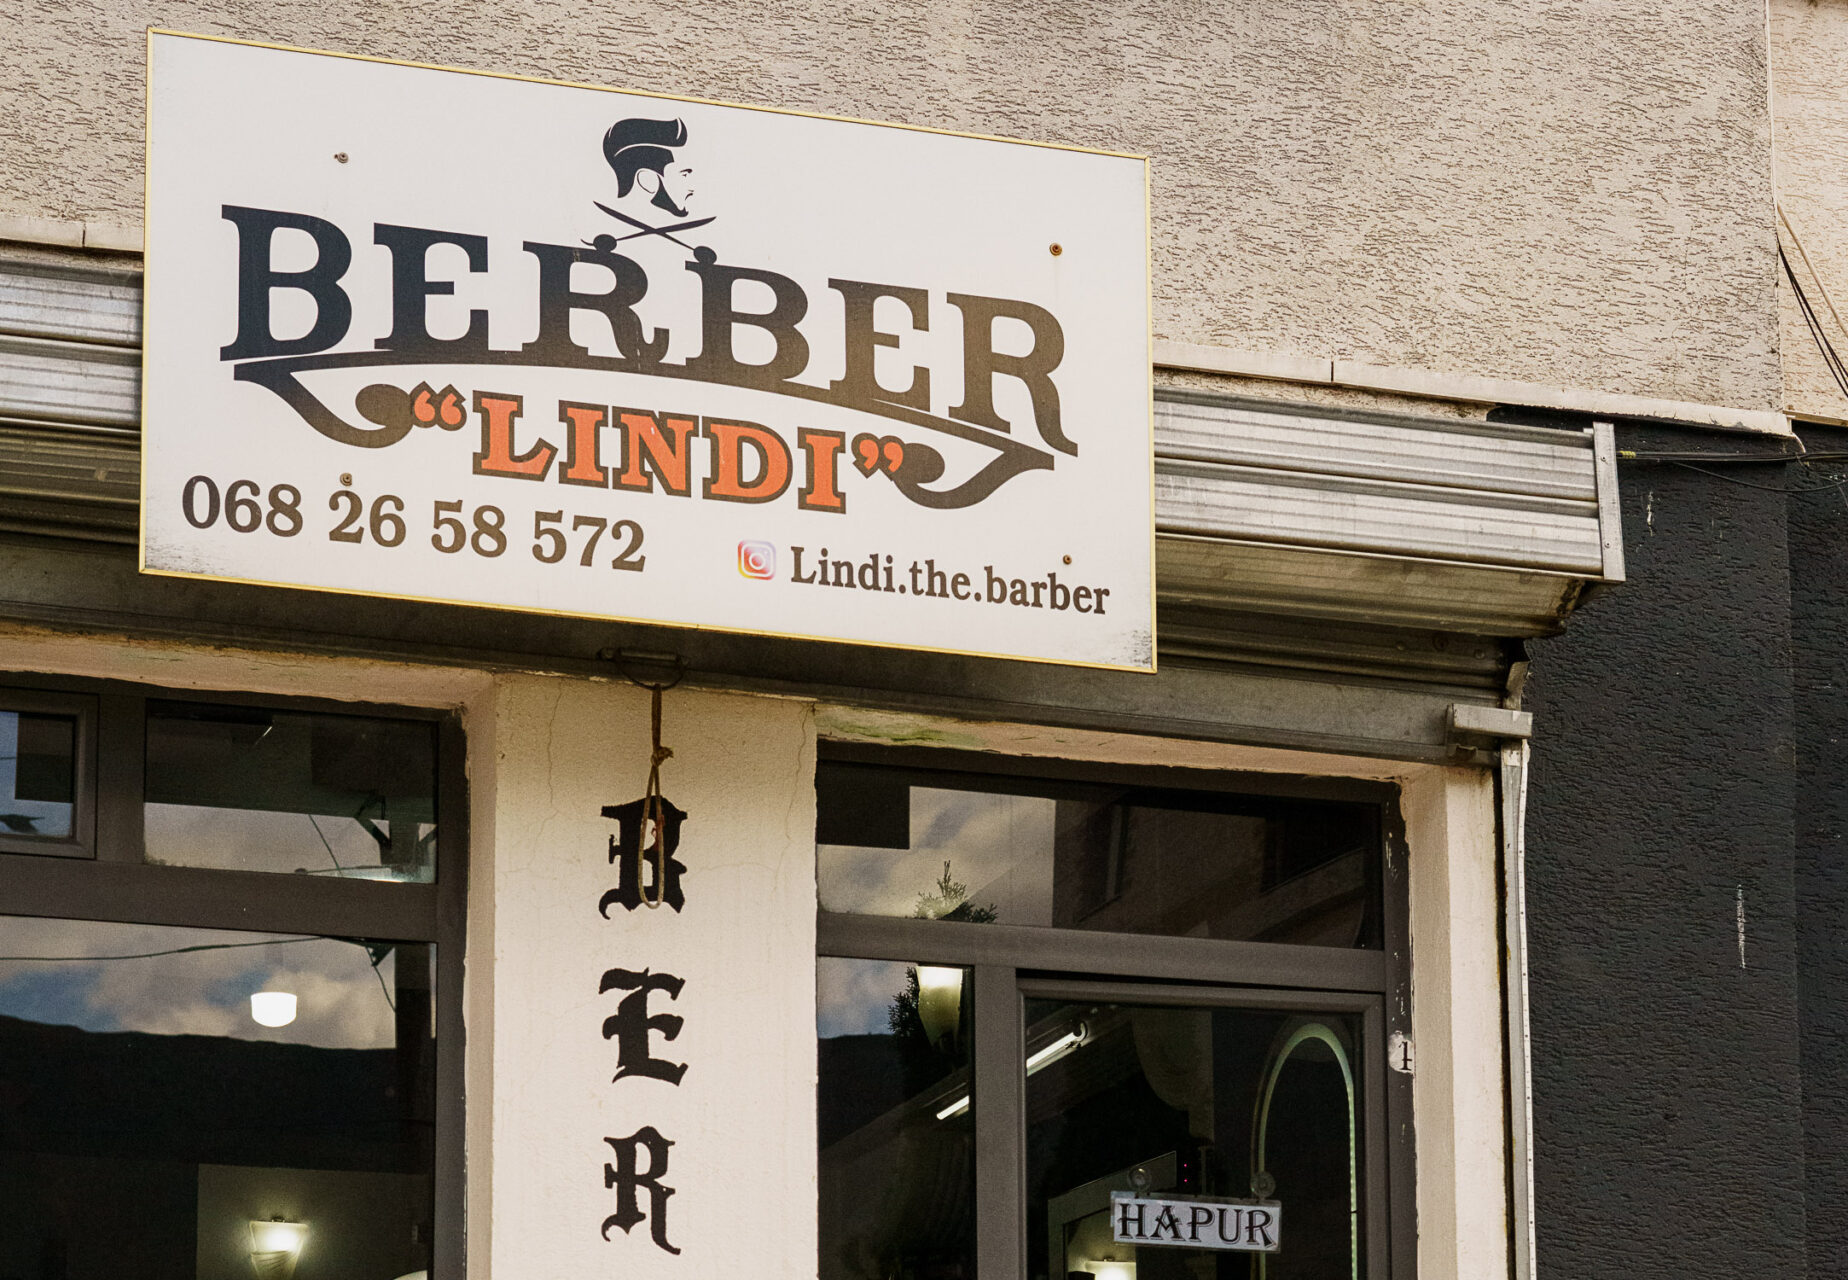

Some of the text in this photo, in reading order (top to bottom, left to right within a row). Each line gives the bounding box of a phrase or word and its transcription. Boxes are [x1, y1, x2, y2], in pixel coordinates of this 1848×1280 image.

[220, 203, 1079, 458] BERBER
[181, 475, 647, 573] 068 26 58 572
[790, 546, 1111, 615] Lindi.the.barber
[1117, 1202, 1276, 1248] HAPUR
